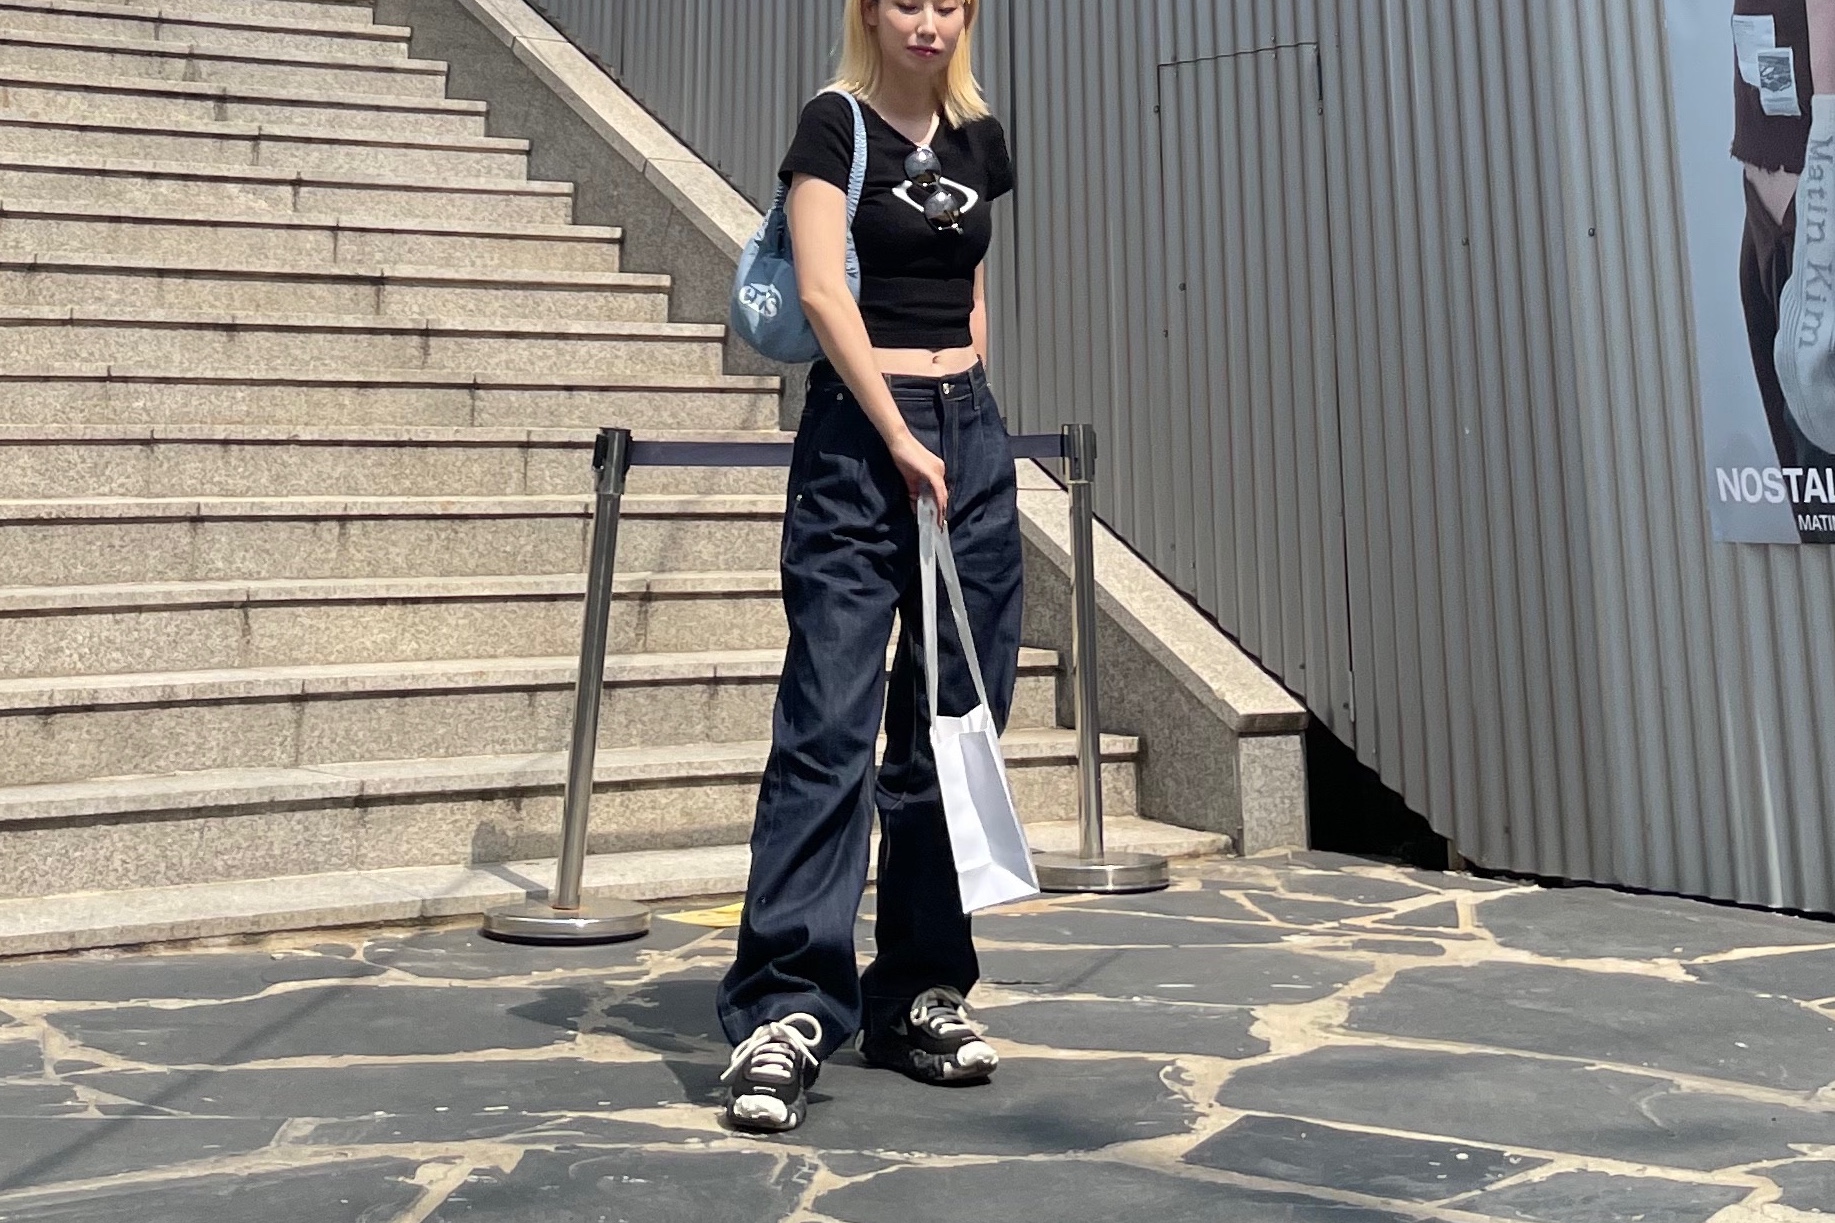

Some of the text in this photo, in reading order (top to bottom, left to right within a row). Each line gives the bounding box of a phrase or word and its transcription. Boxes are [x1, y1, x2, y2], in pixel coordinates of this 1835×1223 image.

[1799, 135, 1834, 349] Matin Kim
[1715, 466, 1835, 504] NOSTAL
